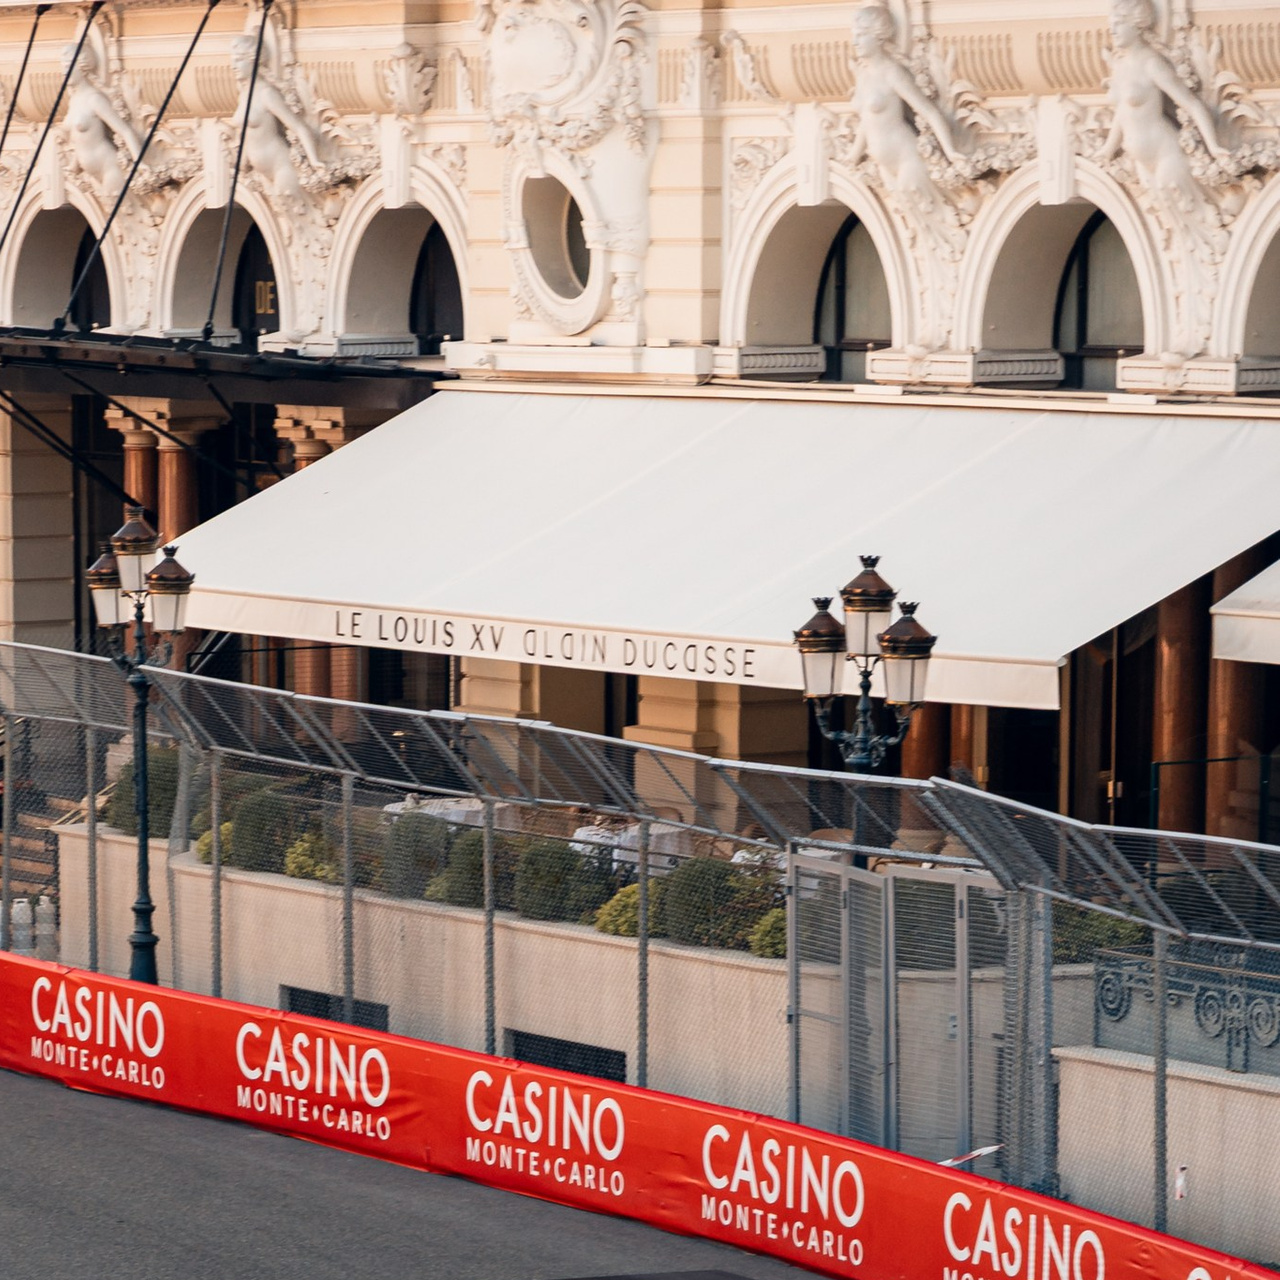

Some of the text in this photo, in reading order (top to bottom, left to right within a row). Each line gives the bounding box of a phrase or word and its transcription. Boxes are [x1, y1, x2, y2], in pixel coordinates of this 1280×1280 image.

[335, 609, 363, 638] LE
[378, 613, 455, 648] LOUIS
[469, 622, 505, 652] XV
[31, 976, 165, 1058] CASINO
[235, 1022, 391, 1108] CASINO
[465, 1070, 625, 1161] CASINO
[702, 1124, 865, 1228] CASINO
